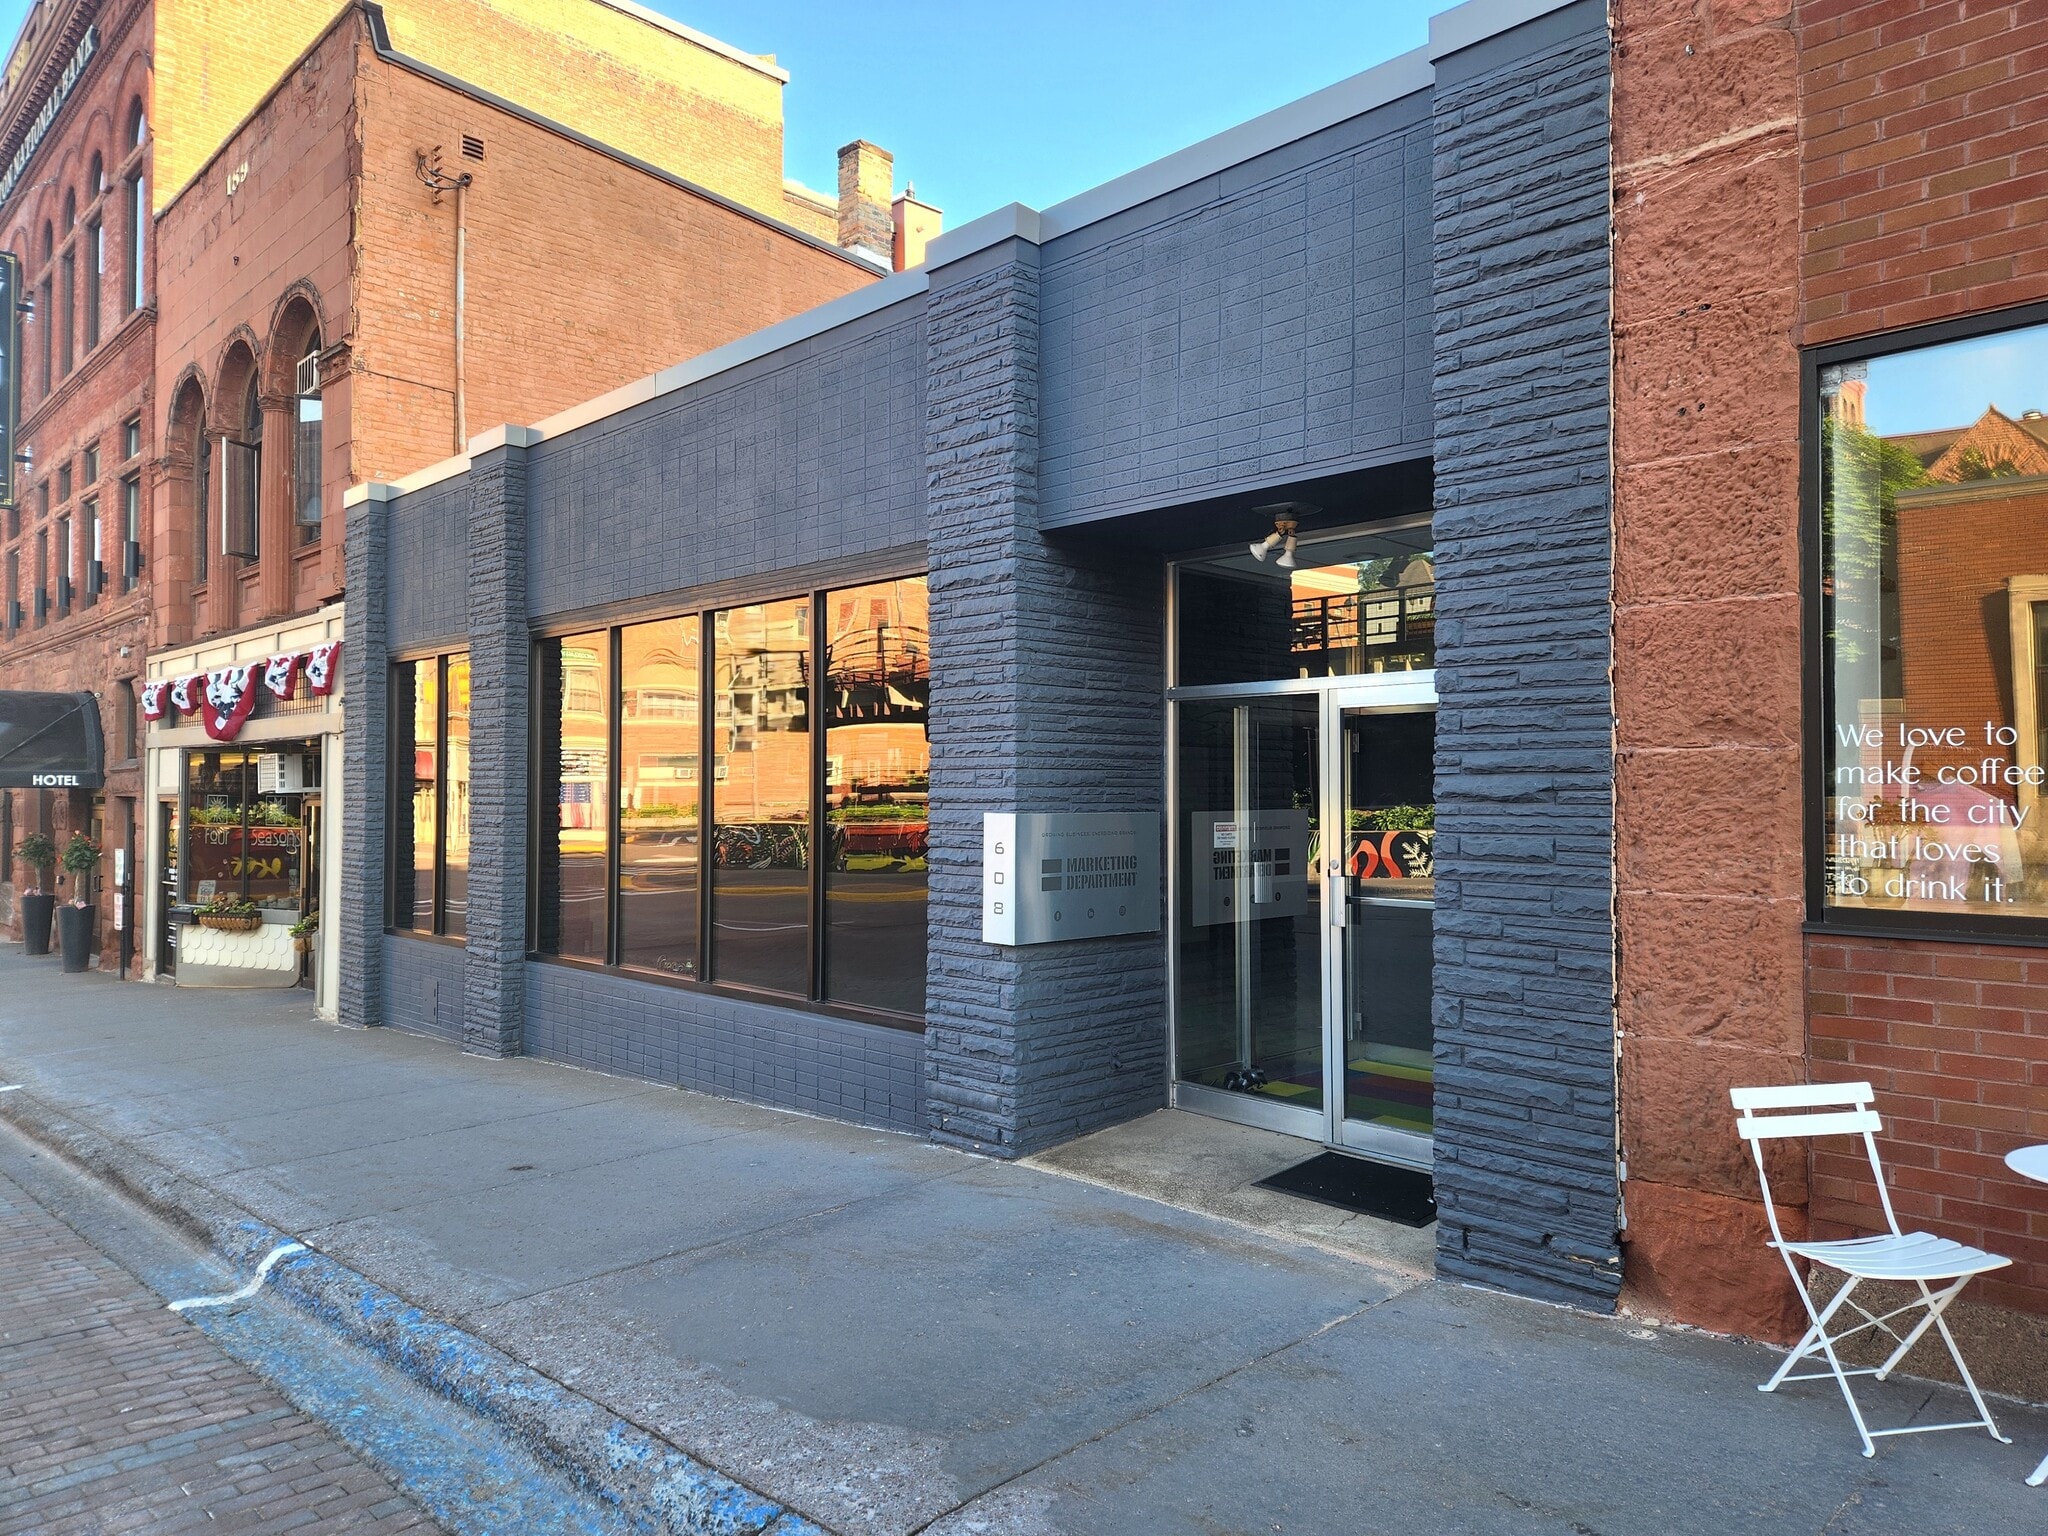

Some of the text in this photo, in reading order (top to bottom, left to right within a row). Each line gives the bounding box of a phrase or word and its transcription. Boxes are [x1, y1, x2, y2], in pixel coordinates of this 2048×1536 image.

[13, 85, 62, 182] NATIONAL
[61, 24, 98, 100] BANK
[1837, 720, 2018, 747] We love to
[32, 774, 80, 786] HOTEL
[1836, 757, 2046, 786] make coffee
[1838, 795, 2031, 831] for the city
[204, 828, 301, 847] Four Seasons
[1838, 834, 2002, 864] that loves
[1066, 855, 1138, 873] MARKETING
[1066, 872, 1138, 890] DEPARTMENT
[1838, 870, 1868, 896] to
[1884, 873, 1967, 901] drink
[1984, 876, 2015, 903] it.
